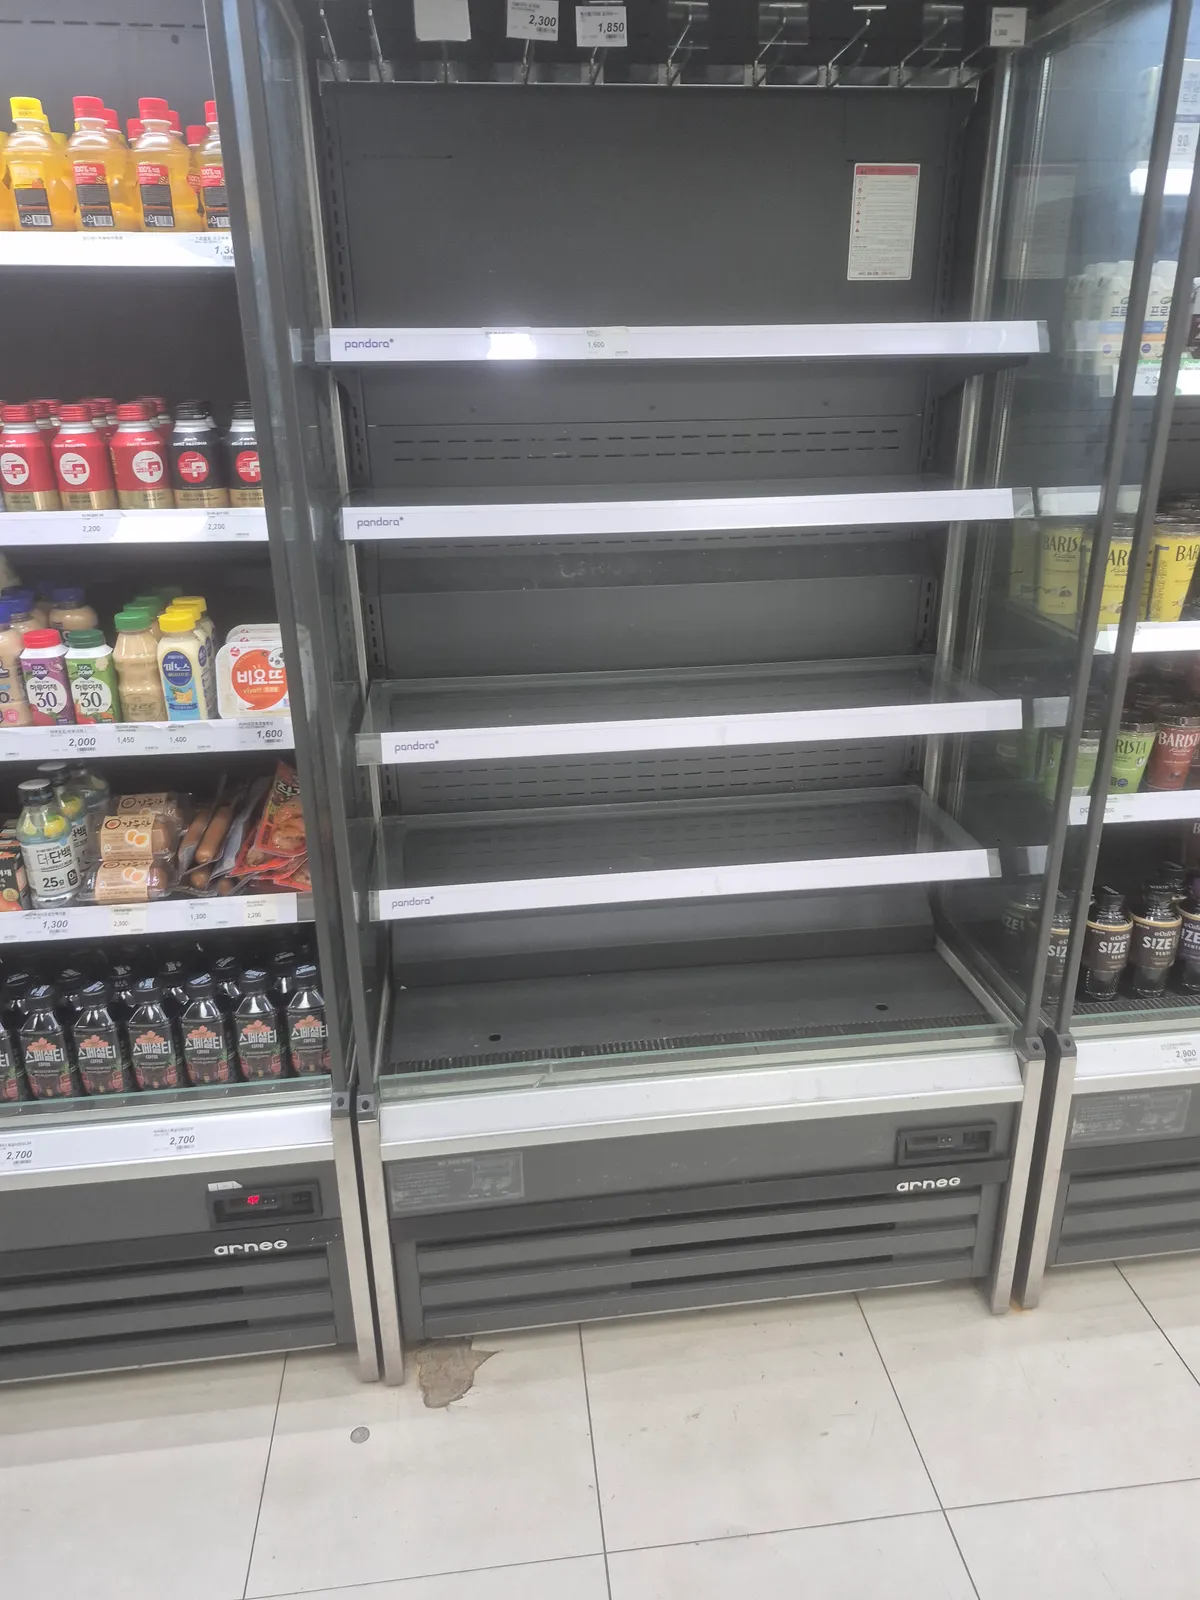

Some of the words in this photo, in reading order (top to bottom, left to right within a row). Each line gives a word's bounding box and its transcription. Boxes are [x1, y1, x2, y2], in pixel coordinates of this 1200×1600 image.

[529, 15, 556, 26] 2,300
[598, 22, 624, 33] 1,850
[344, 338, 390, 351] pandora
[587, 341, 605, 349] 1,600
[207, 523, 226, 531] 2,200
[357, 517, 399, 529] pandora
[82, 525, 101, 533] 2,200
[237, 669, 284, 685] 비요뜨
[30, 683, 58, 691] 하루야채
[75, 683, 103, 691] 하루야채
[36, 691, 58, 707] 30
[80, 691, 102, 707] 30
[257, 729, 283, 739] 1,600
[69, 738, 96, 747] 2,000
[117, 736, 135, 744] 1,450
[395, 741, 435, 754] pandora
[392, 898, 431, 909] pandora
[42, 920, 68, 929] 1,300
[291, 1024, 329, 1039] 스페셜티
[185, 1036, 223, 1050] 스페셜티
[239, 1030, 277, 1045] 스페셜티
[78, 1045, 117, 1059] 스페셜티
[132, 1040, 171, 1055] 스페셜티
[26, 1050, 64, 1064] 스페셜티
[1176, 1050, 1197, 1058] 2,900
[170, 1136, 195, 1145] 2,700
[6, 1150, 33, 1160] 2,700
